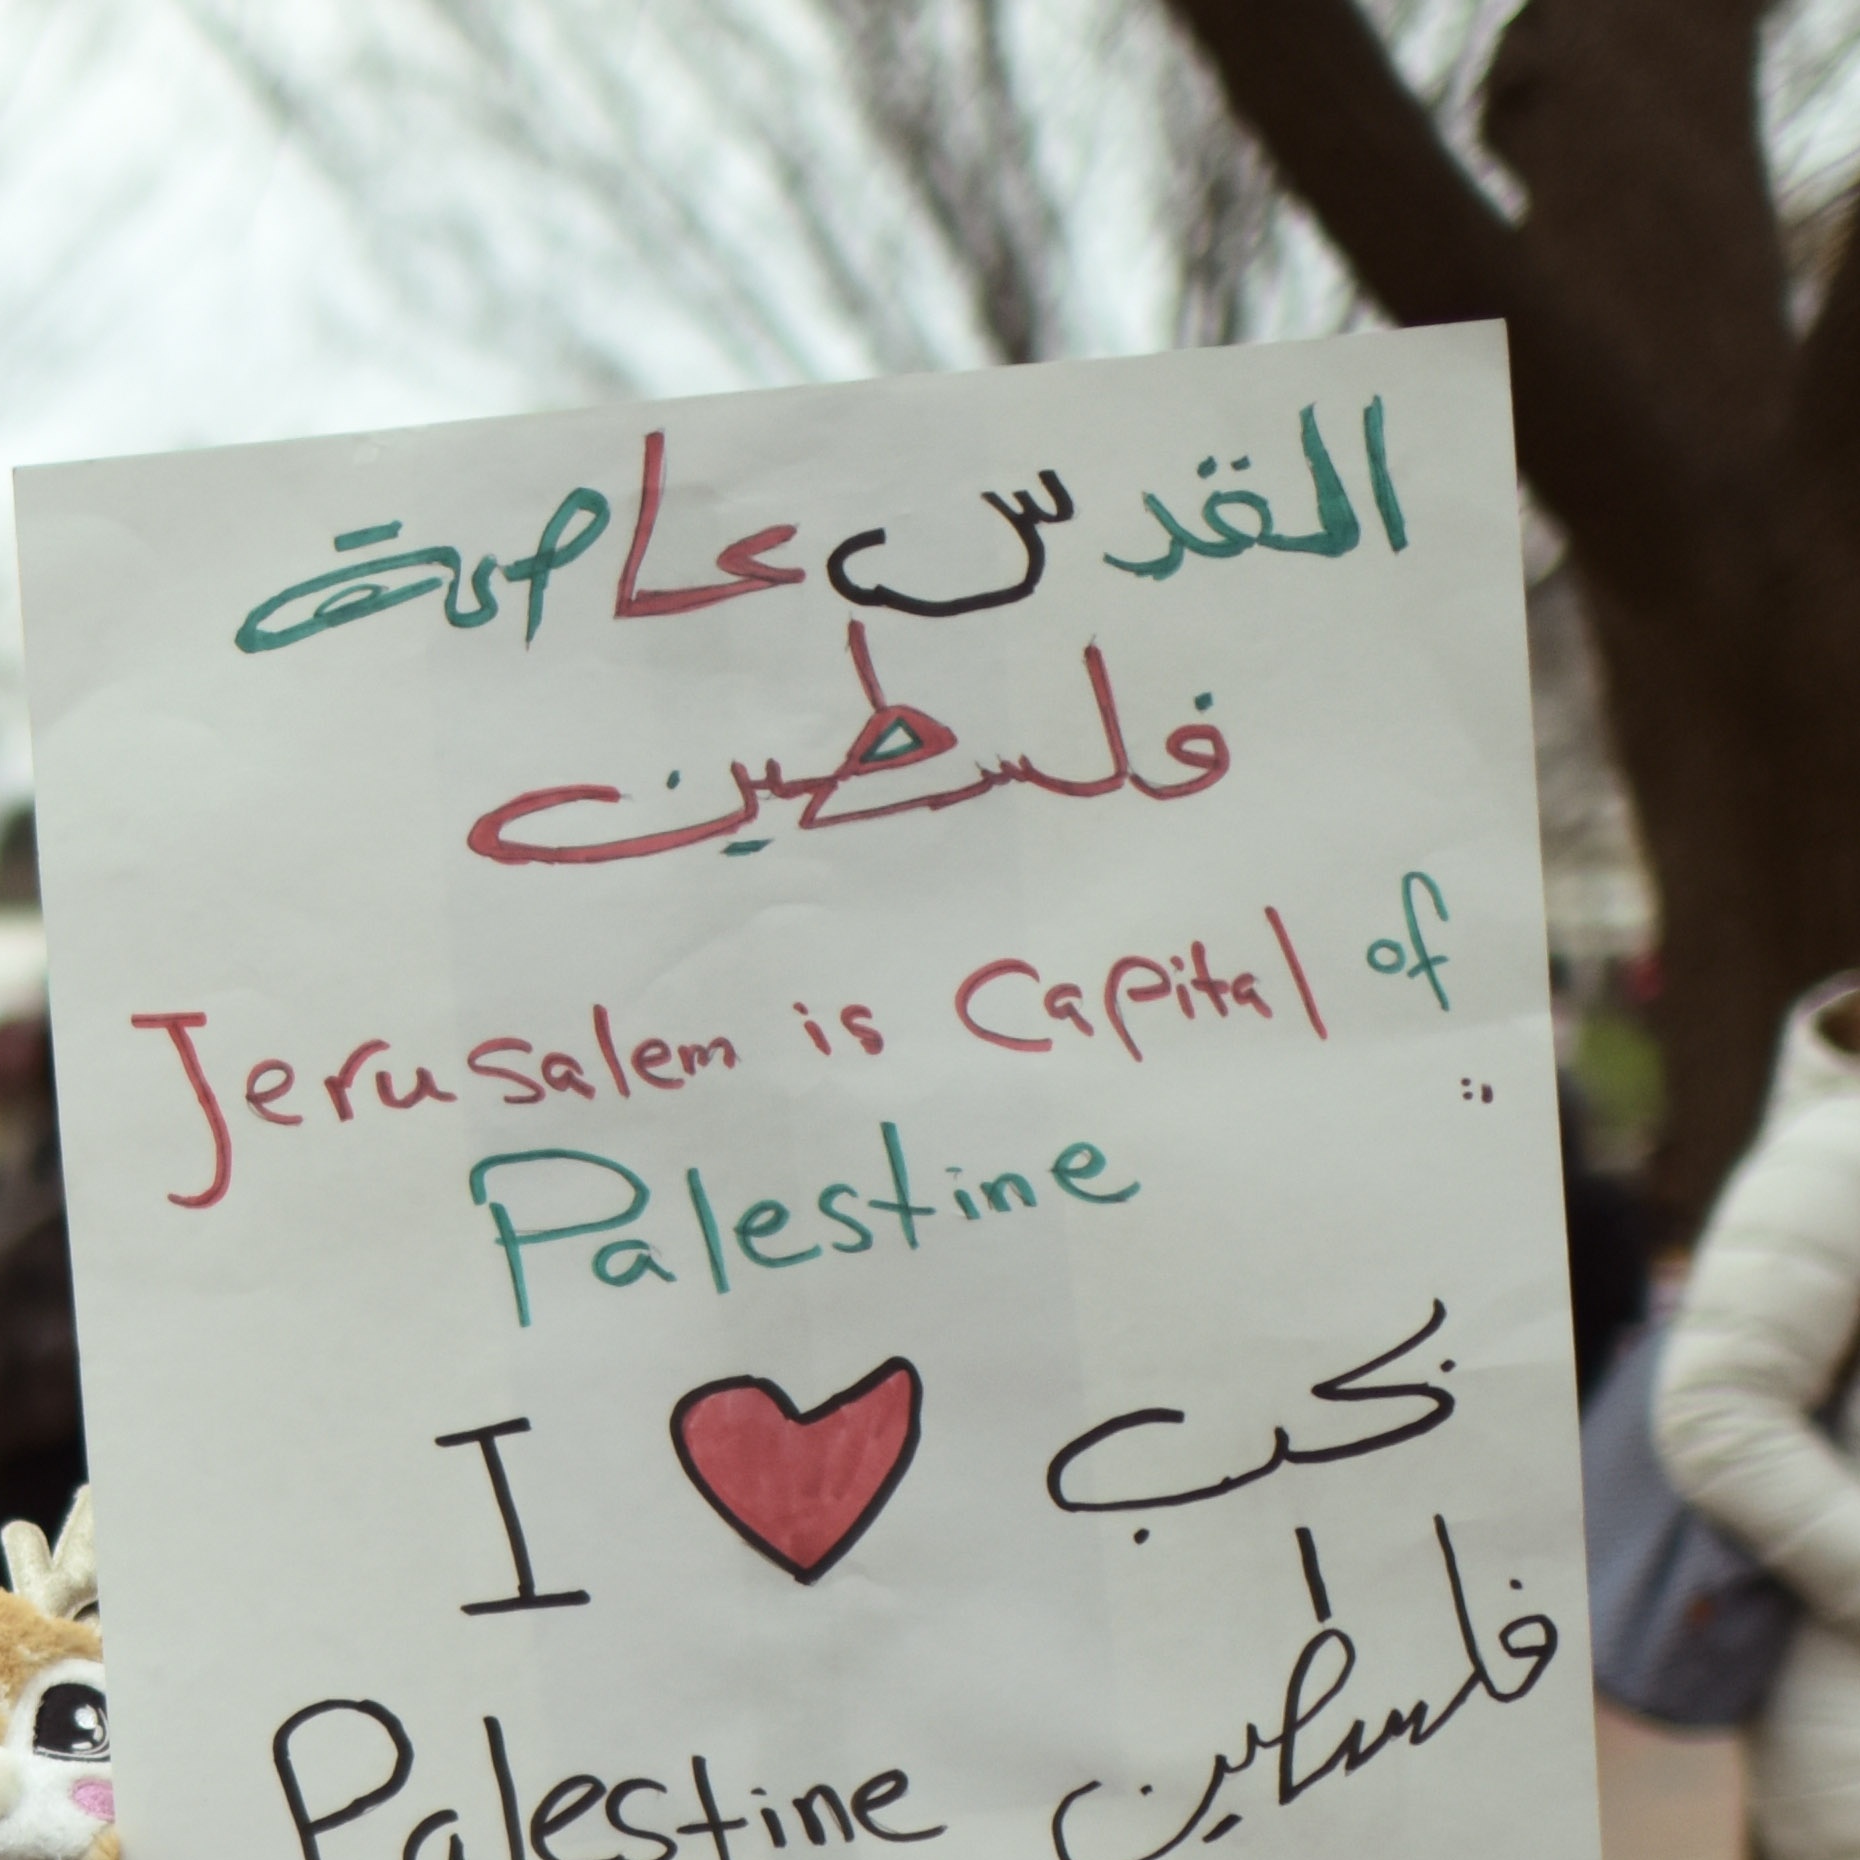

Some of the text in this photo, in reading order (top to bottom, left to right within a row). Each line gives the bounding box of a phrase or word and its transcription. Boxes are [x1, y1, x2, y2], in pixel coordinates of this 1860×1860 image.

[825, 393, 1409, 618] القدس
[466, 618, 1231, 866] فلسطين
[130, 1004, 738, 1212] Jerusalem
[792, 1001, 885, 1057] is
[1365, 871, 1451, 1013] of
[468, 1120, 1141, 1329] Palestine
[433, 1416, 592, 1616] I
[1045, 1297, 1457, 1545] نحب
